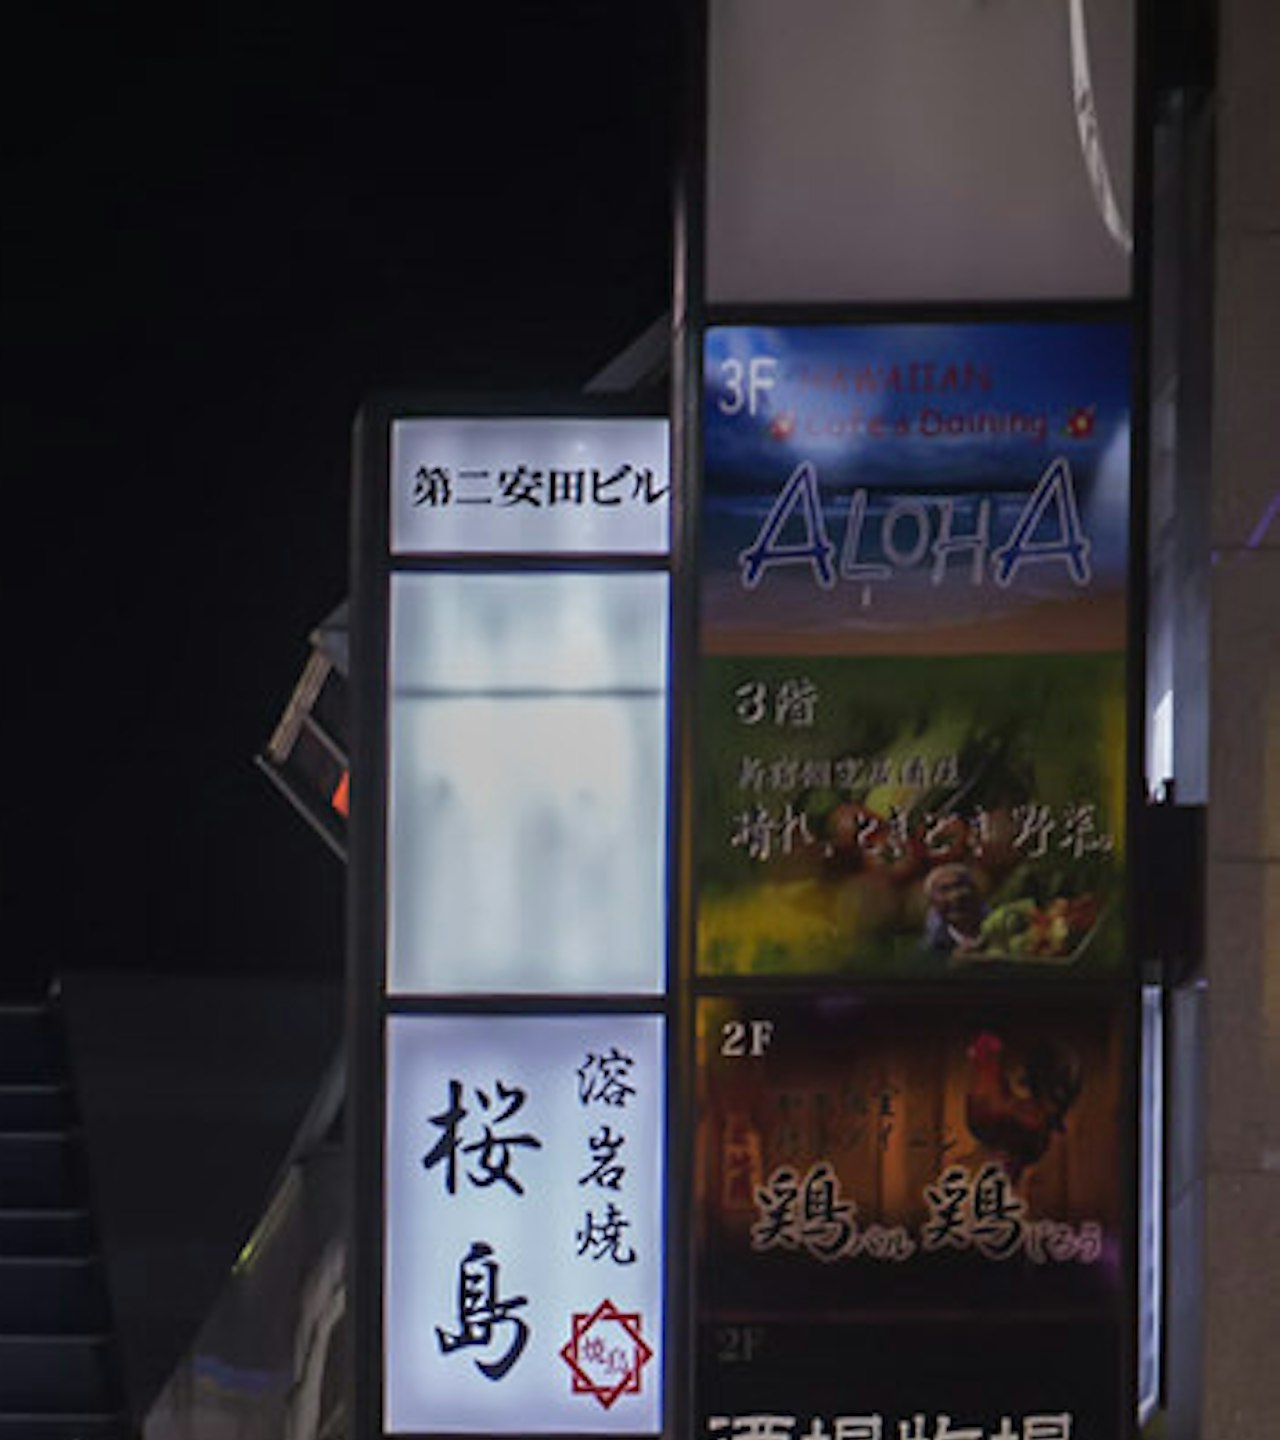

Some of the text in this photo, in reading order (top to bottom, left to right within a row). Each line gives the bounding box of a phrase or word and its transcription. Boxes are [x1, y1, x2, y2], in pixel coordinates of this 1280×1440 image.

[720, 358, 778, 416] 3F
[412, 465, 669, 508] 第二安田ビル
[740, 456, 1092, 590] ALOHA
[722, 1022, 774, 1058] 2F
[422, 1080, 542, 1382] 桜島
